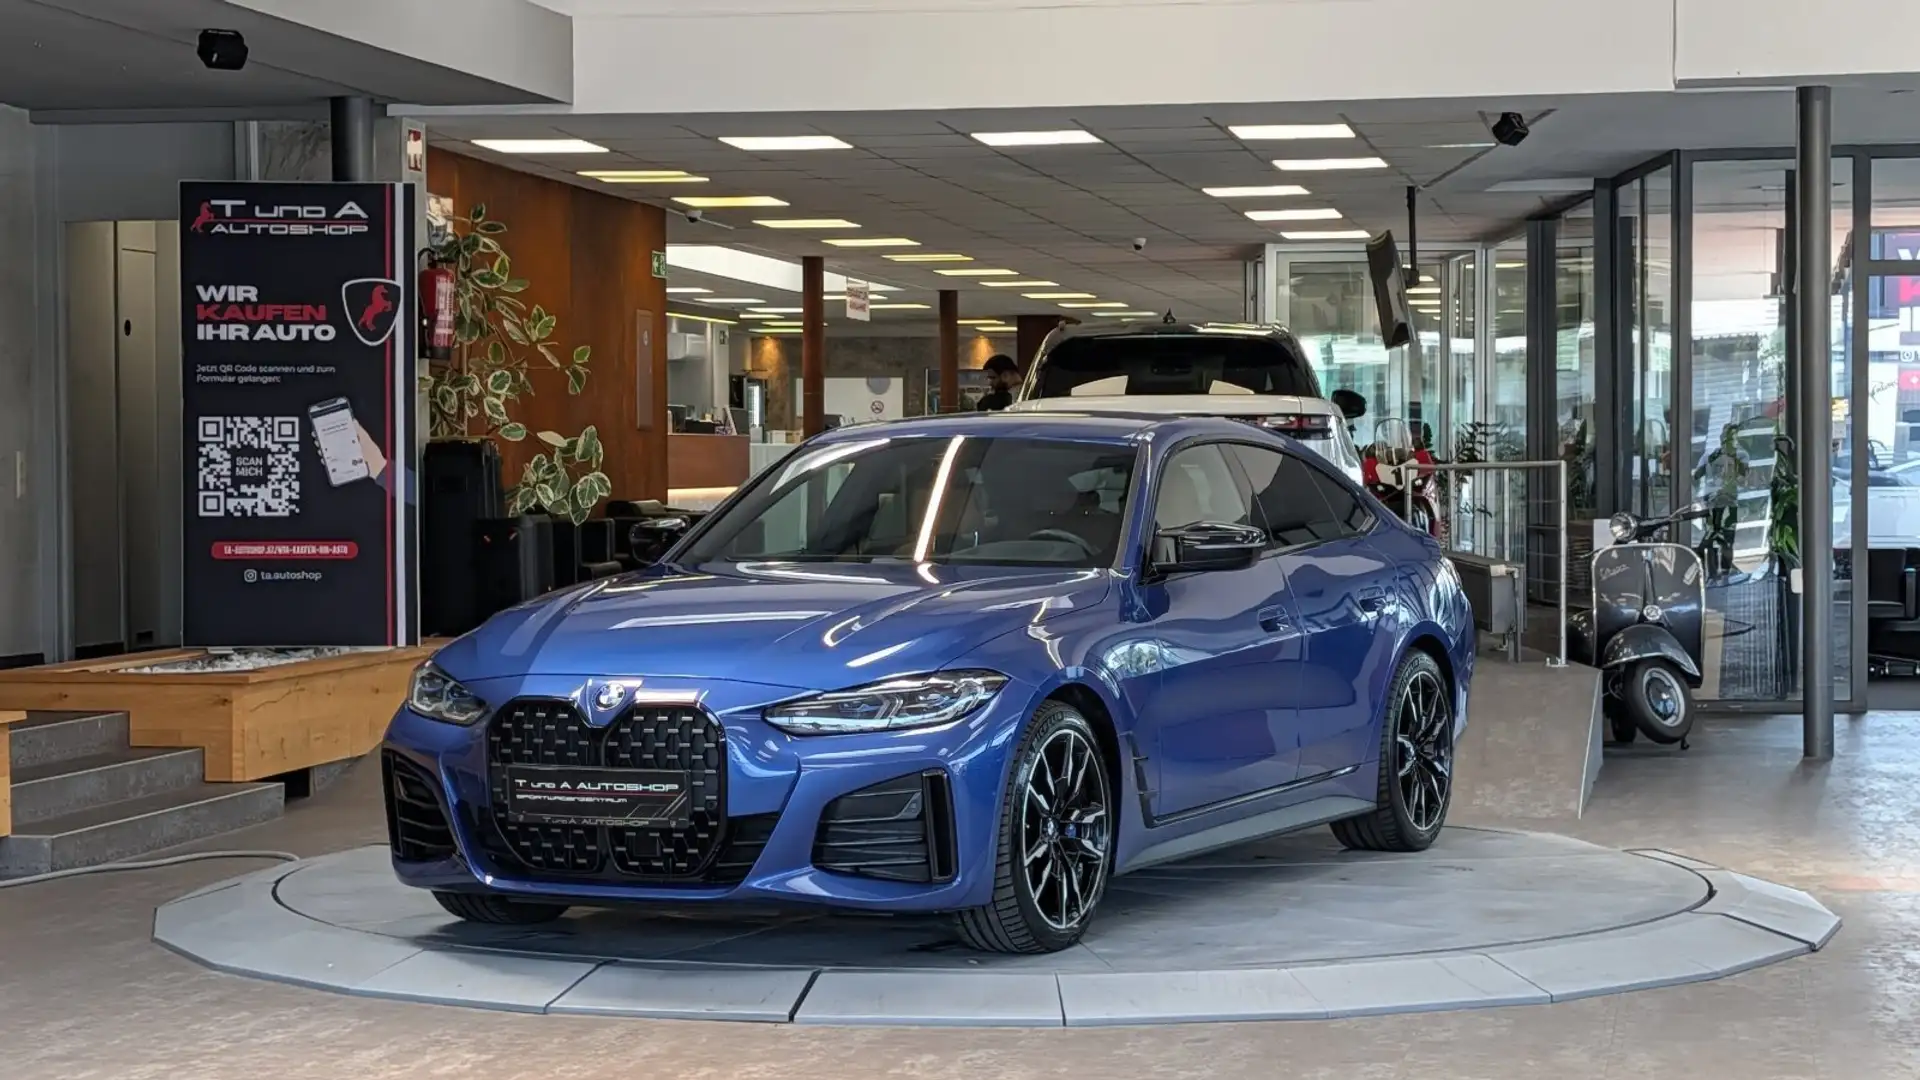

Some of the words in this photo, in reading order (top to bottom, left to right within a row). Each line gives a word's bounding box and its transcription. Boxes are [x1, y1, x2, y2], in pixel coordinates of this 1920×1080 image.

[210, 200, 246, 217] T
[334, 201, 369, 218] A
[210, 224, 368, 235] AUTOSHOP
[196, 285, 258, 302] WIR
[196, 304, 326, 321] KAUFEN
[196, 324, 249, 341] IHR
[252, 324, 336, 341] AUTO
[196, 364, 218, 373] Jetzt
[219, 364, 232, 374] QR
[234, 364, 257, 373] Code
[258, 365, 296, 373] scannen
[297, 364, 314, 373] und
[316, 365, 336, 373] zum
[196, 374, 236, 383] Formular
[238, 374, 281, 384] gelangen:
[236, 457, 263, 466] SCAN
[235, 467, 263, 476] MICH
[260, 570, 322, 581] ta.autoshop
[515, 779, 527, 787] T
[560, 781, 572, 790] A
[576, 782, 679, 792] AUTOSHOP
[581, 818, 650, 827] AUTOSHOP
